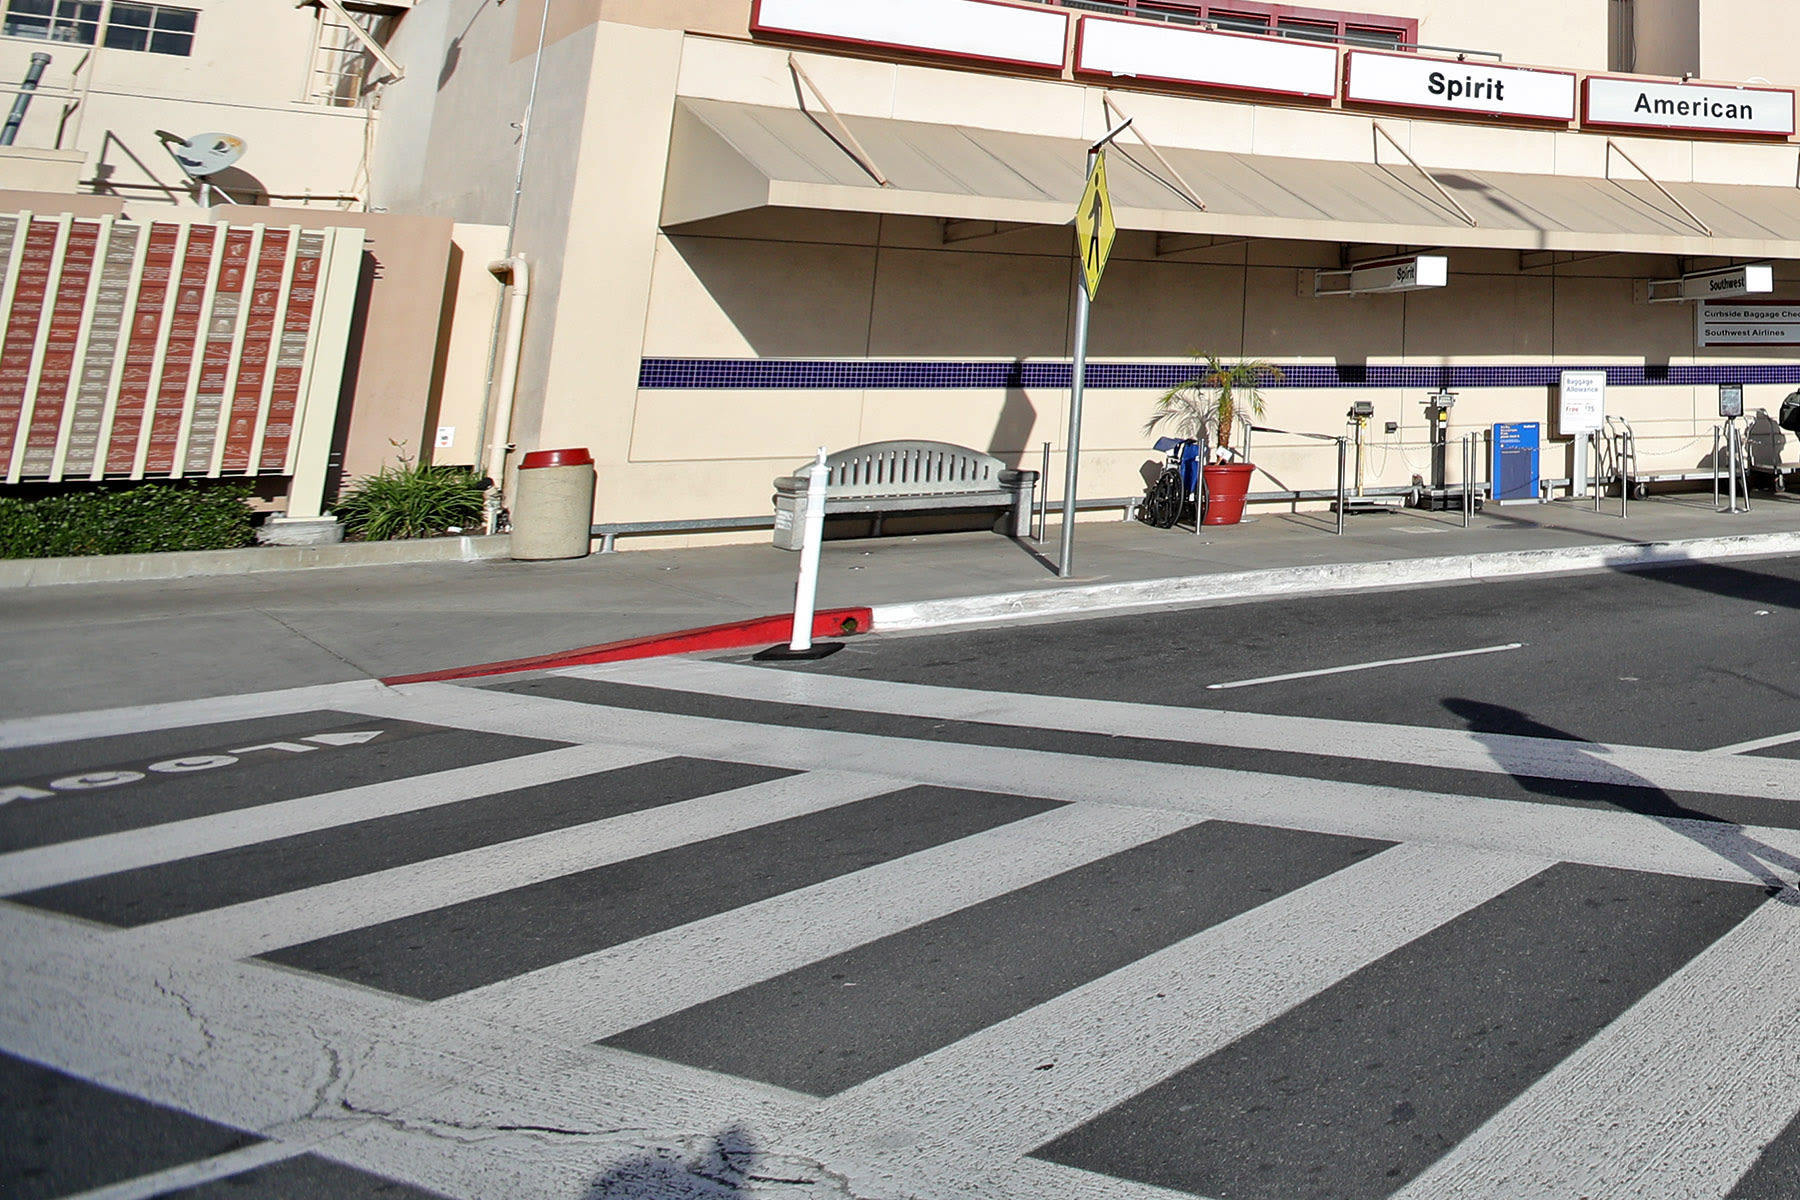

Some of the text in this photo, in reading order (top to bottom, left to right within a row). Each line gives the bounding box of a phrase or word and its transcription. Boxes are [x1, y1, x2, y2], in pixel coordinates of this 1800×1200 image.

[1427, 71, 1505, 102] Spirit
[1633, 92, 1754, 121] American
[1397, 266, 1415, 283] Spirit
[1709, 276, 1745, 292] Southwest
[1704, 310, 1742, 318] Curbside
[1743, 310, 1780, 319] Baggage
[1704, 329, 1785, 337] Southwest Airlines
[1566, 378, 1594, 386] Baggage
